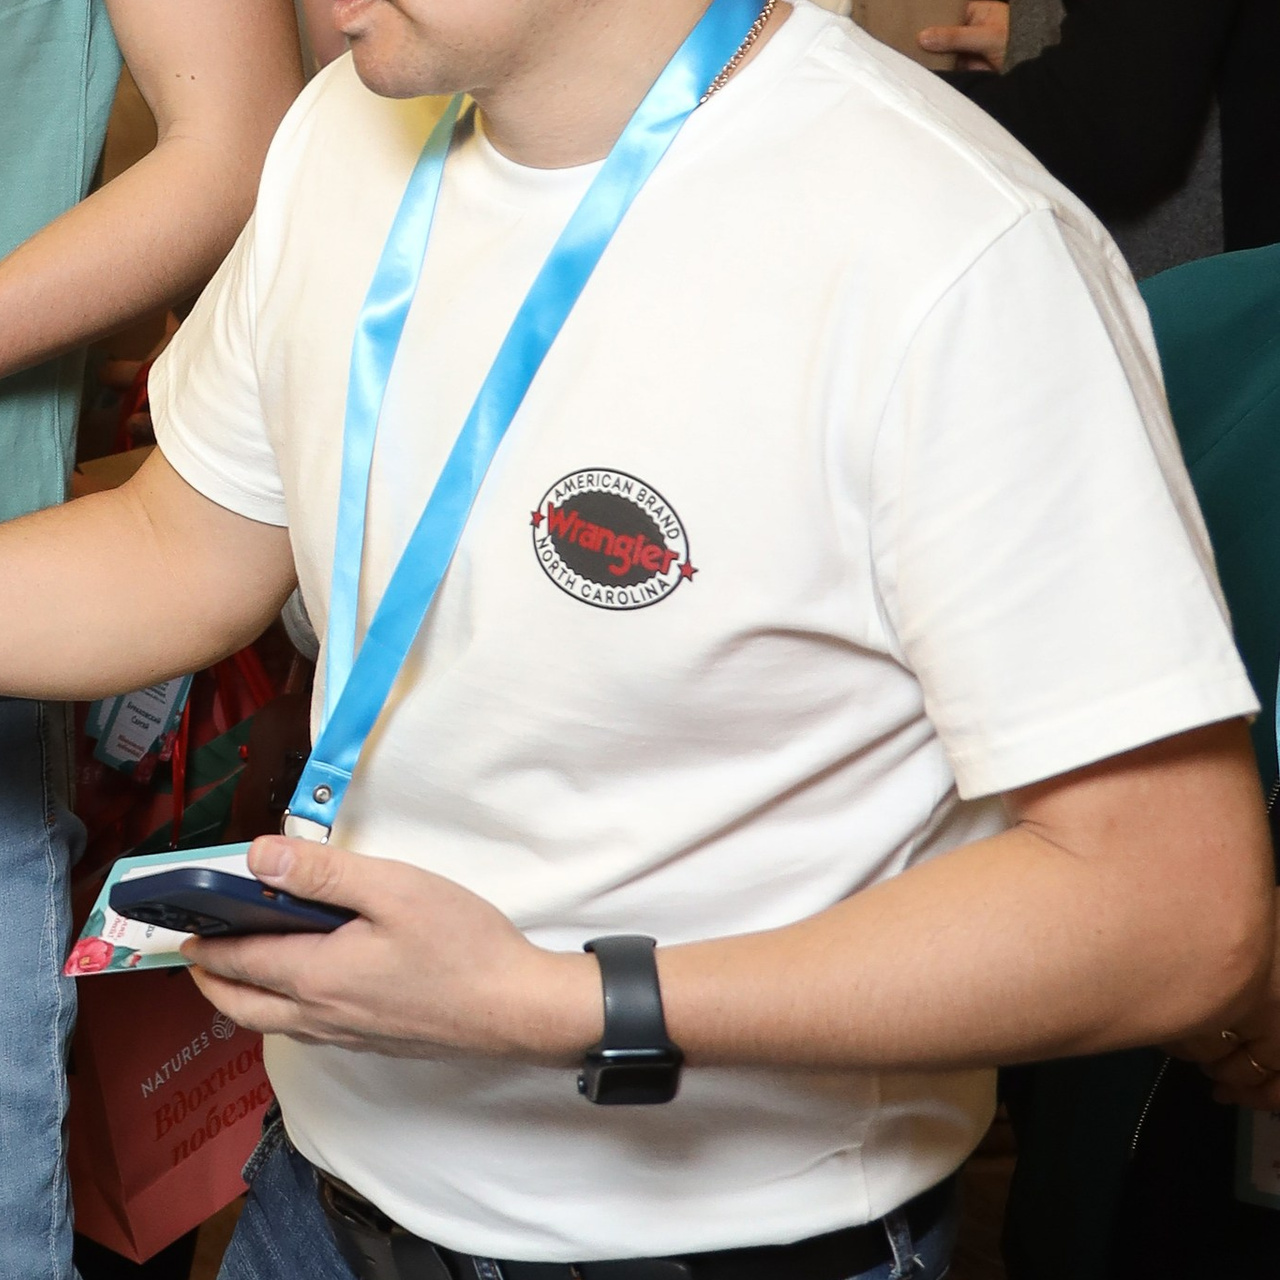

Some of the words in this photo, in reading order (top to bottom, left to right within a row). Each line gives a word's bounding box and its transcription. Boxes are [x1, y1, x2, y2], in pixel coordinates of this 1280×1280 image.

[548, 501, 679, 576] Wrangler
[554, 474, 634, 502] AMERICAN
[636, 489, 679, 540] BRAND
[537, 537, 575, 589] NORTH
[581, 578, 670, 604] CAROLINA
[141, 1031, 210, 1098] NATURES
